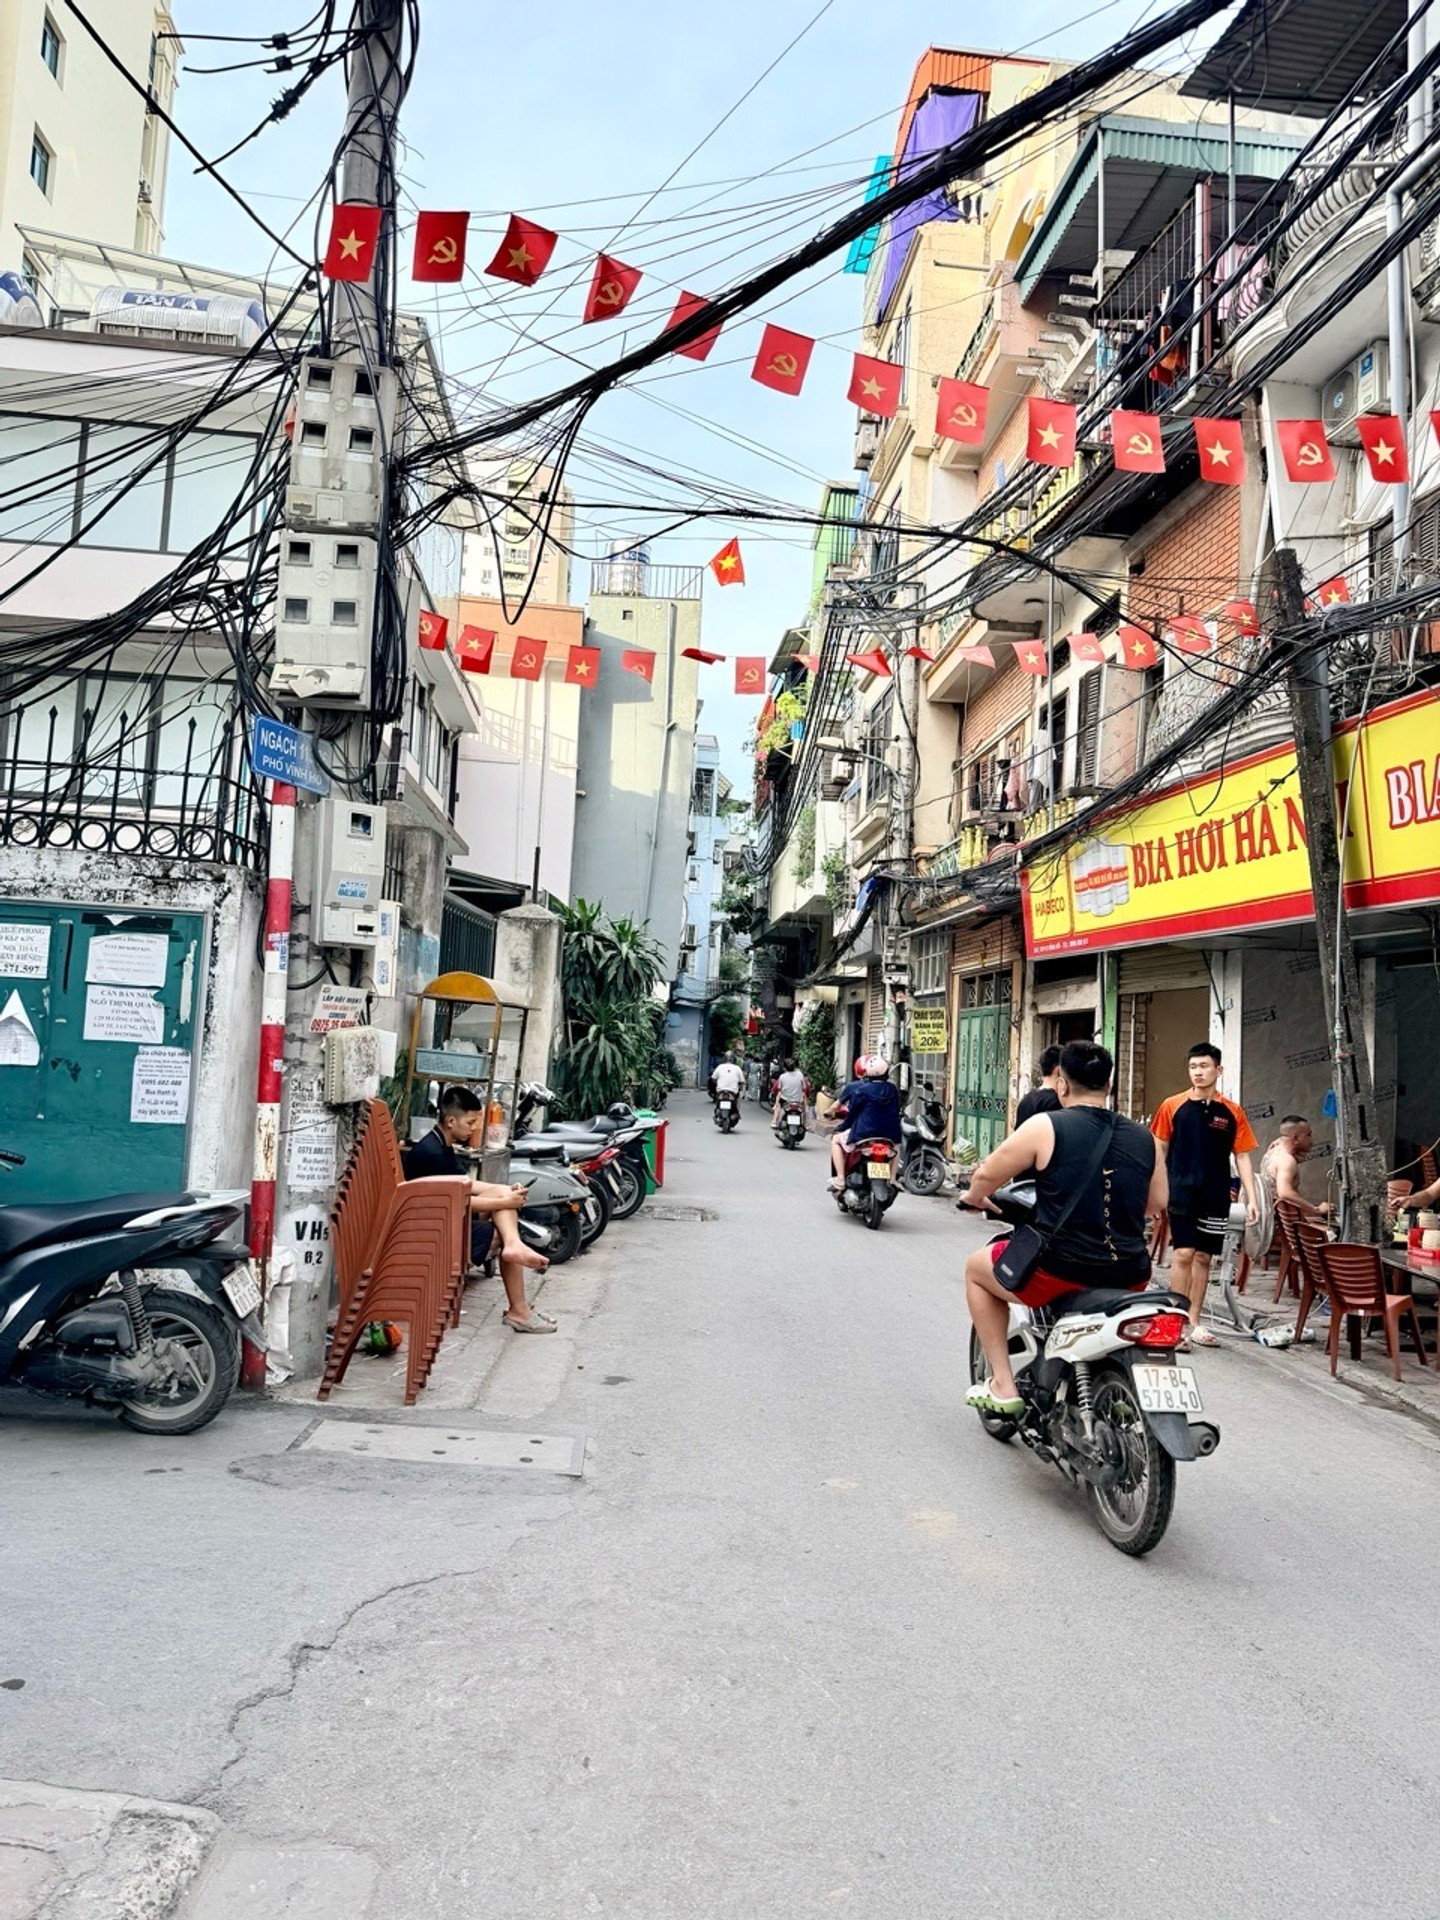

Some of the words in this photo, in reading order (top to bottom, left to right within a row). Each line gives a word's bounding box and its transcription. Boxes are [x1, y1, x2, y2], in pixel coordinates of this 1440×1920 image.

[260, 727, 297, 758] NGÁCH
[262, 755, 285, 771] PHỐ
[1132, 835, 1174, 889] BIA
[1175, 817, 1228, 878] HƠI
[1231, 789, 1281, 865] HÀ
[1035, 896, 1066, 917] HABECO
[920, 1037, 940, 1046] 20k
[1143, 1368, 1188, 1388] 17-B4
[1141, 1389, 1199, 1409] 578.40
